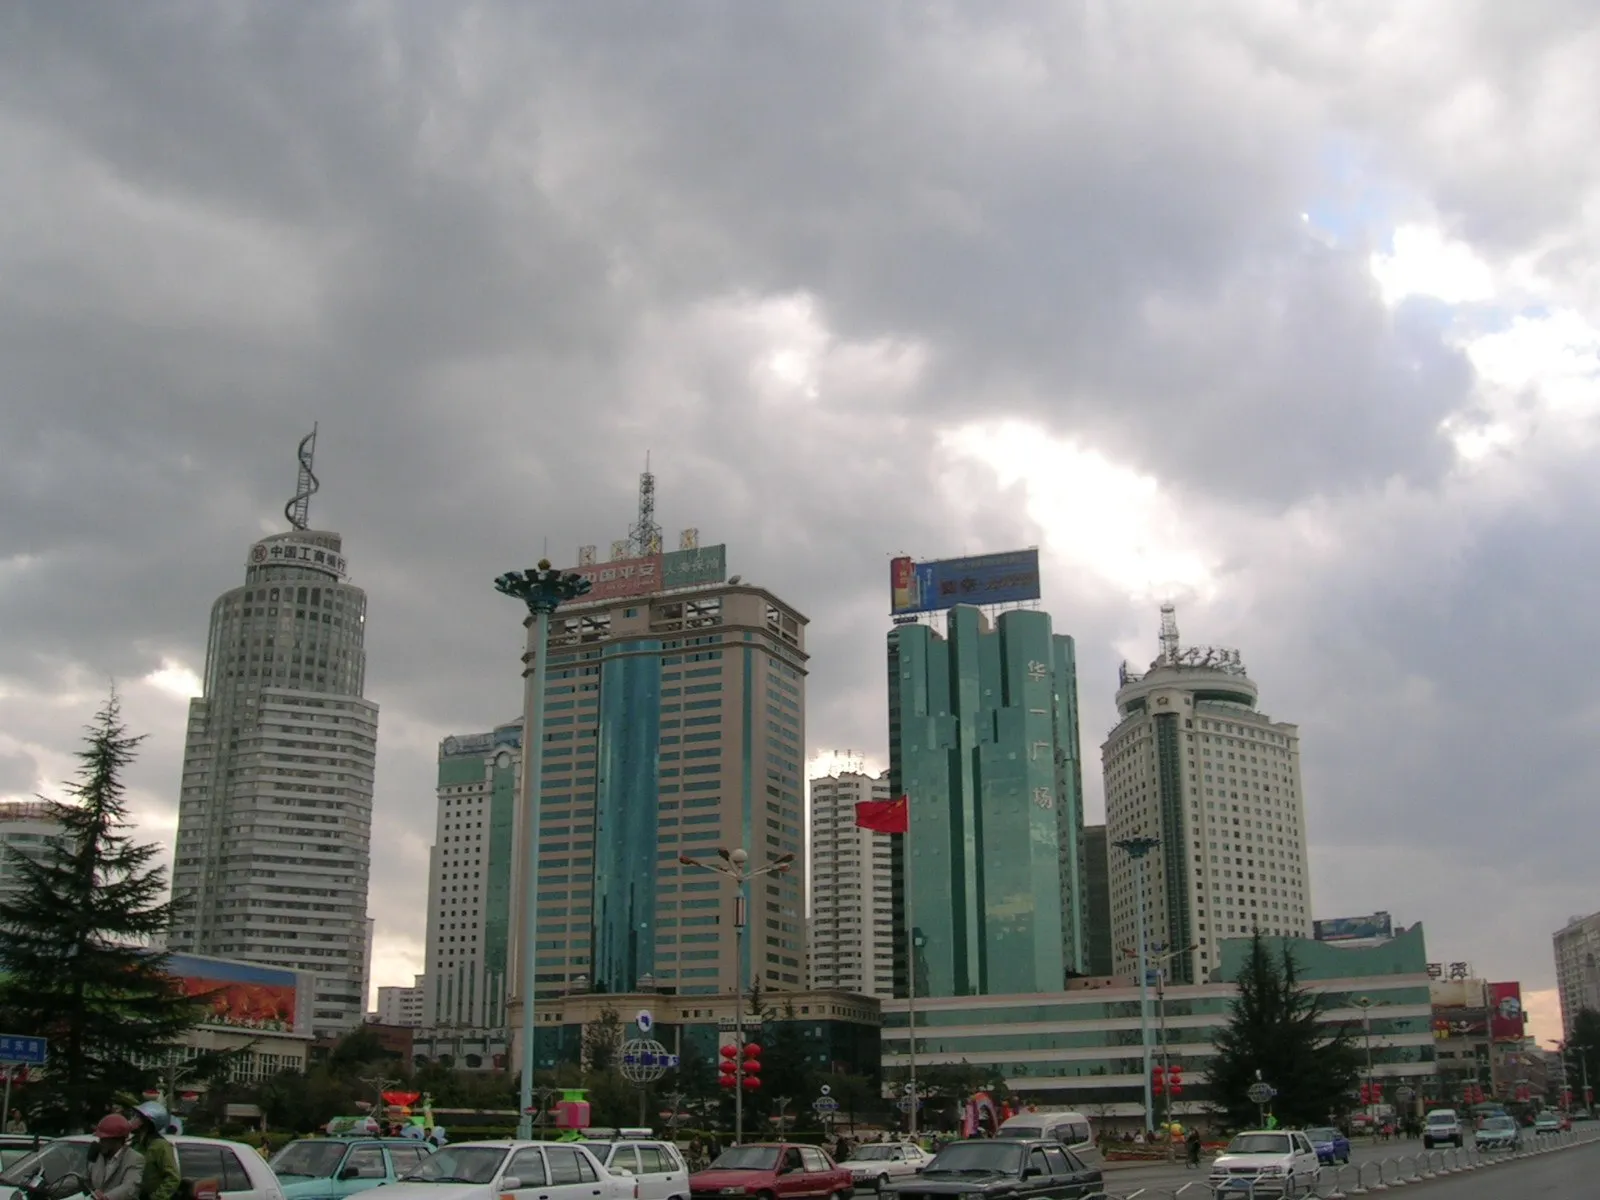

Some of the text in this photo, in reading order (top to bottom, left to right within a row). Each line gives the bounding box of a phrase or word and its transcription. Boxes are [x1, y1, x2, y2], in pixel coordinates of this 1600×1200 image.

[270, 545, 346, 573] 中国工商银行
[1028, 660, 1053, 809] 华一广场
